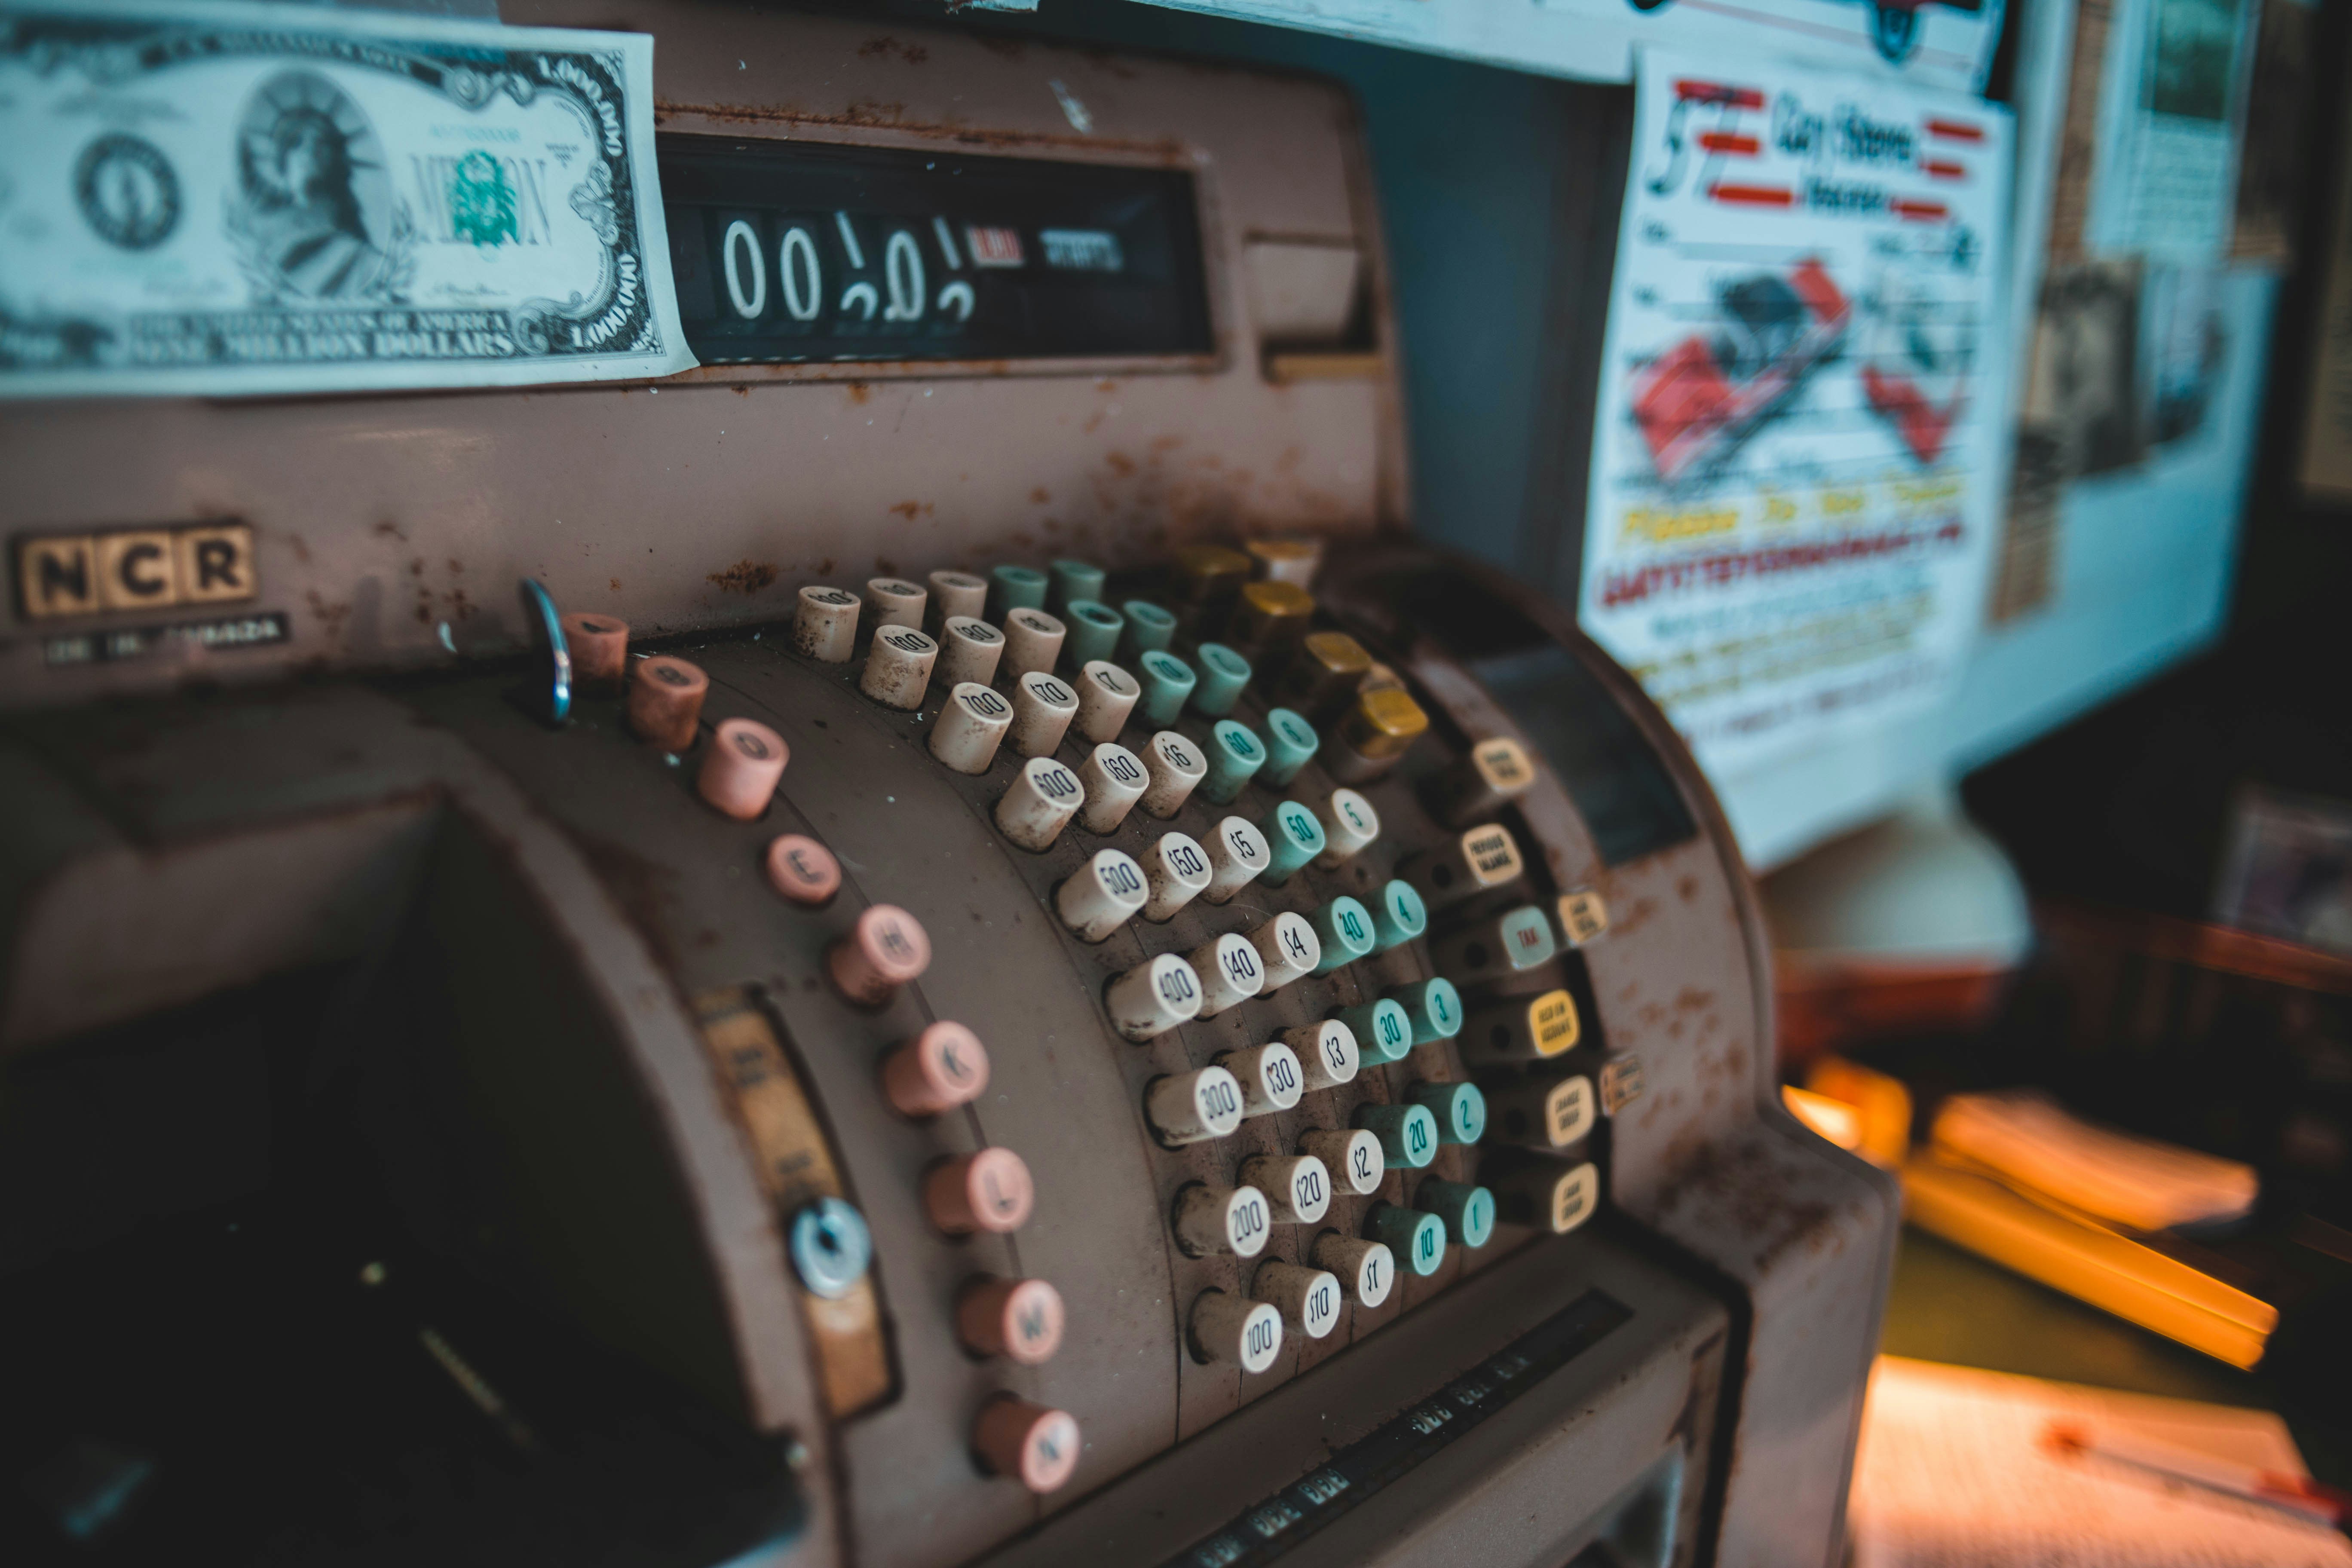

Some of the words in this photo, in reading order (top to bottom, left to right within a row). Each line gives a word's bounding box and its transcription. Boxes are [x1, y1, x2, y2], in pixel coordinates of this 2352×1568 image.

[419, 311, 505, 331] AMERICA
[374, 332, 516, 358] DOLLARS
[41, 536, 241, 603] NCR
[885, 633, 930, 651] 800
[960, 692, 1006, 715] 700
[1224, 732, 1254, 755] 60
[1033, 769, 1076, 799] 600
[1286, 814, 1315, 842] 50
[1344, 802, 1363, 827] 5
[788, 848, 824, 885] E
[1099, 862, 1141, 895] 500
[1397, 895, 1412, 922] 4
[1342, 911, 1365, 941] 40
[1159, 968, 1194, 1004] 400
[1434, 993, 1448, 1022] 3
[1380, 1012, 1402, 1045] 30
[1200, 1081, 1237, 1120] 300
[1460, 1099, 1472, 1130] 2
[1409, 1118, 1427, 1154] 20
[1231, 1200, 1263, 1242] 200
[1472, 1201, 1479, 1231] 1
[1420, 1227, 1434, 1261] 10
[1247, 1318, 1272, 1359] 100
